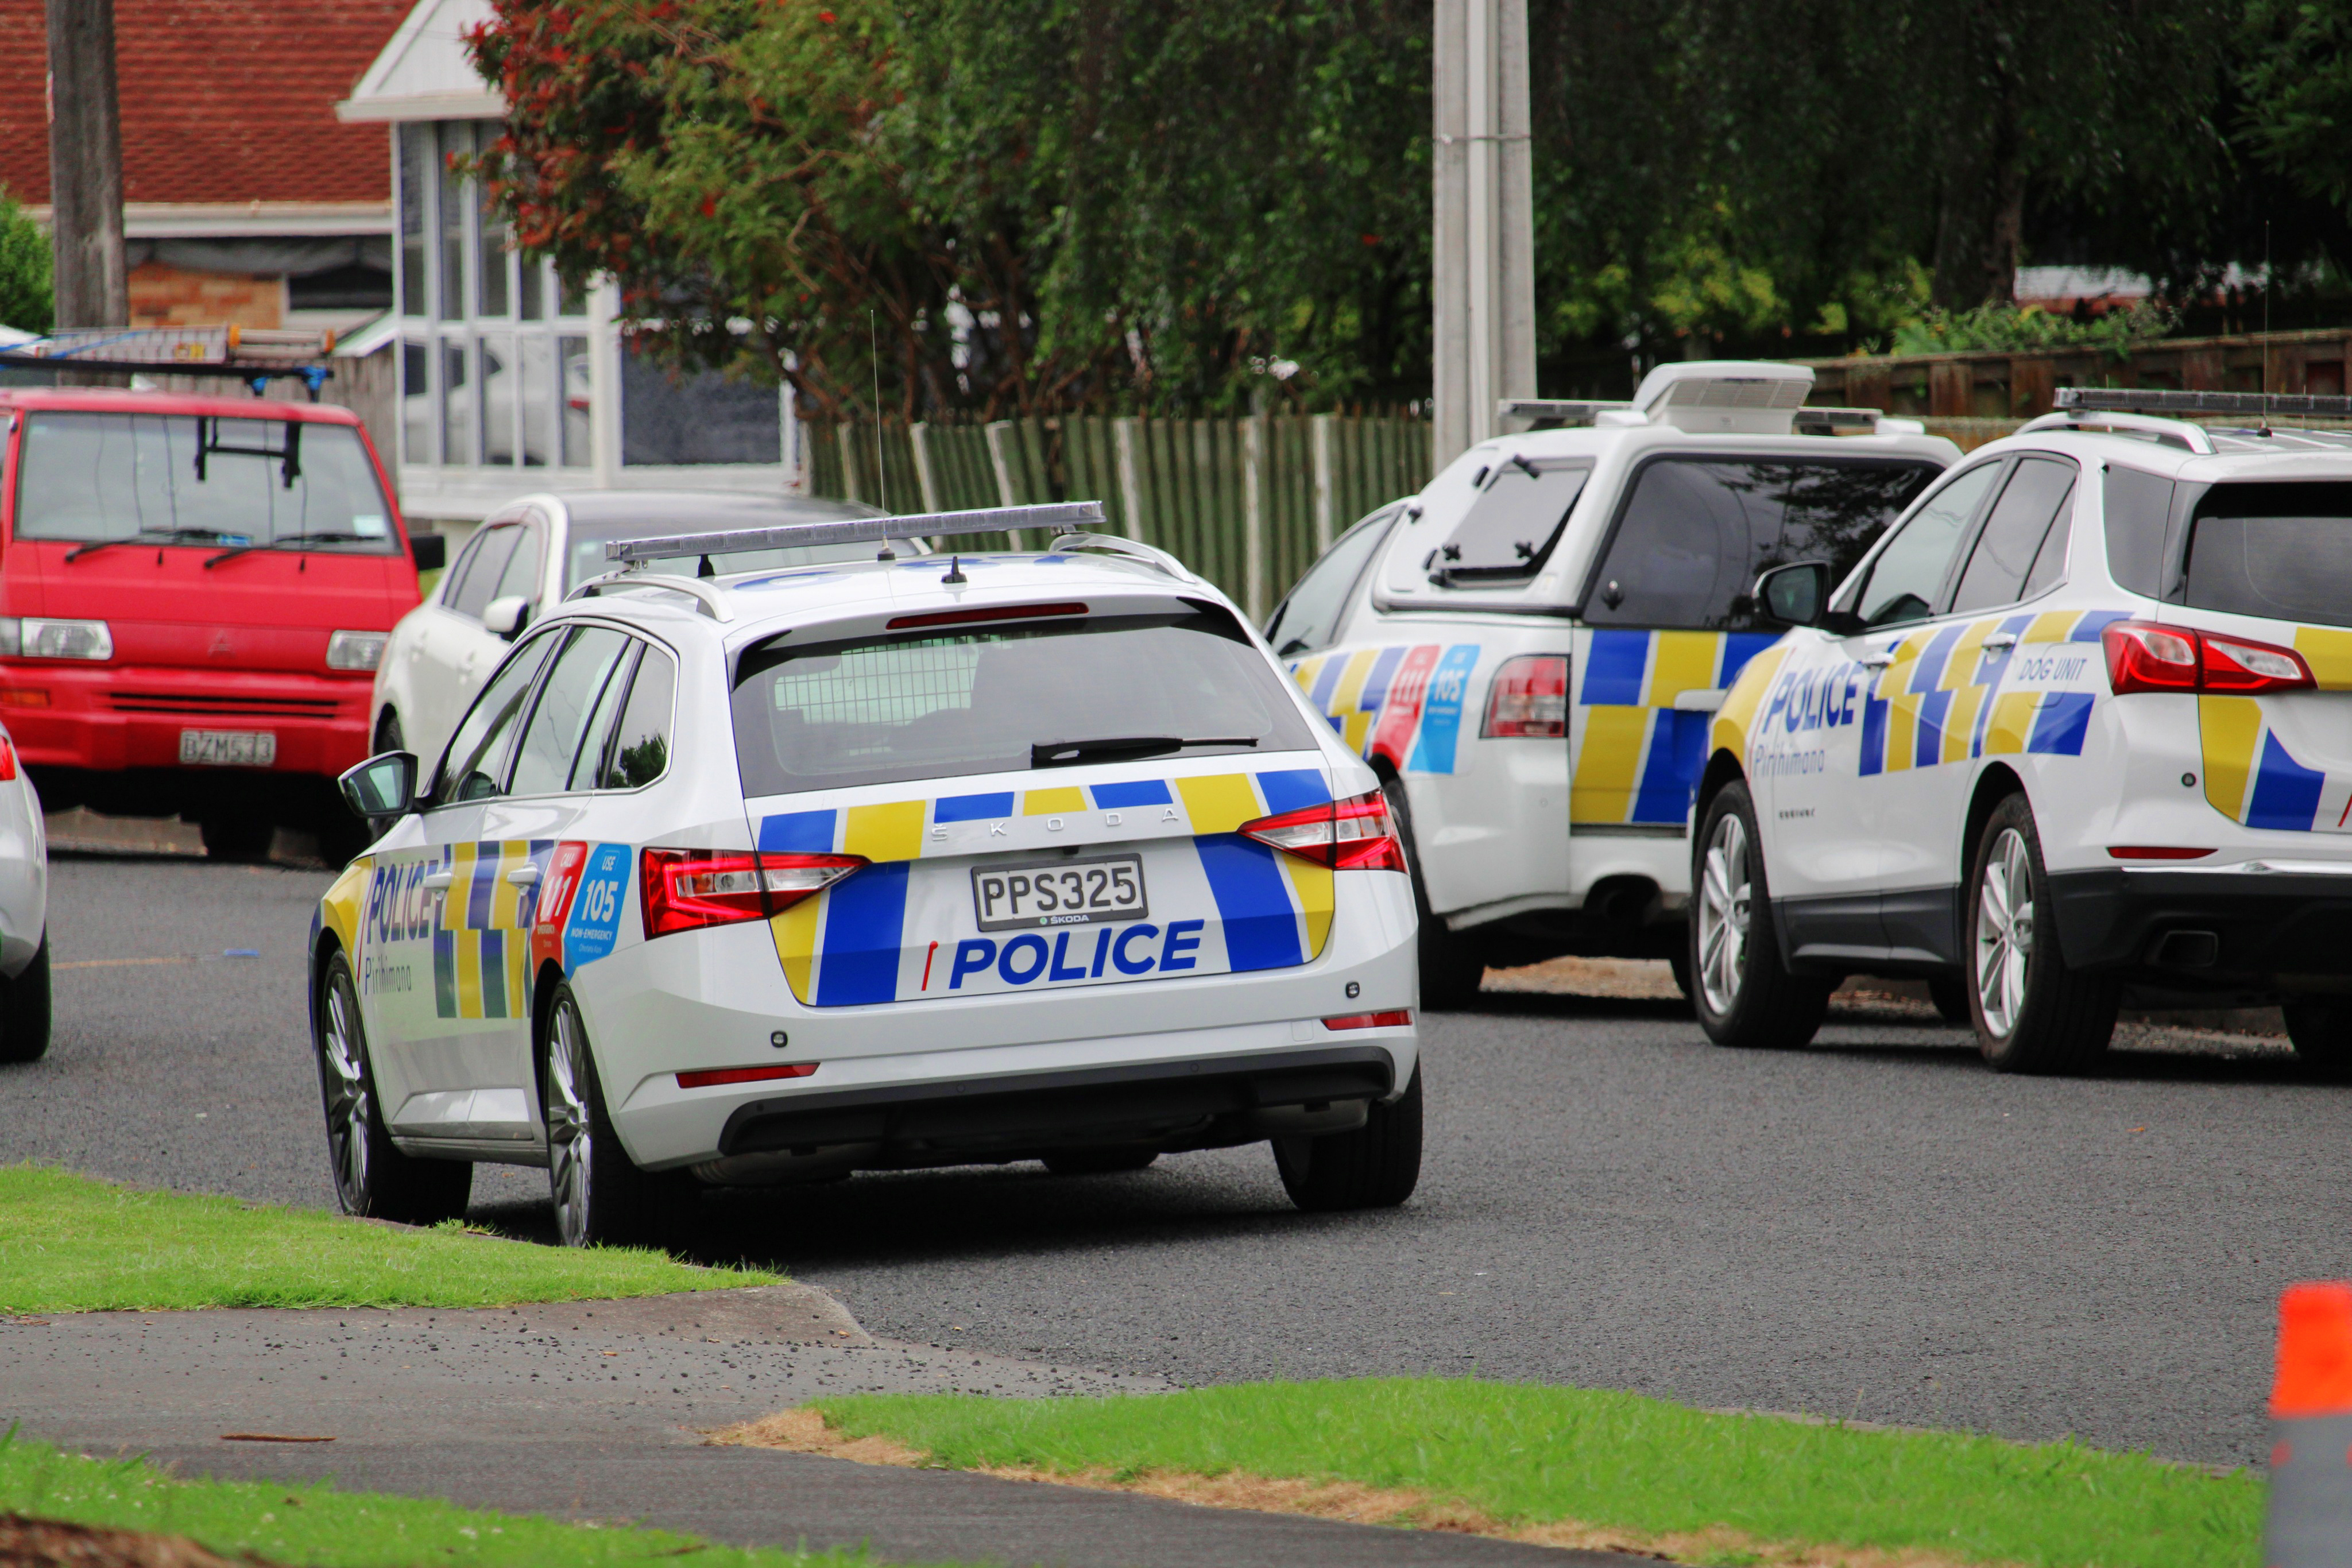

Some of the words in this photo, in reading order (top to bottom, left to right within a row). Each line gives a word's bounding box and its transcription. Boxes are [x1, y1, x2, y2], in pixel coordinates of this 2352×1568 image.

[2018, 657, 2053, 681] DOG
[2053, 657, 2087, 680] UNIT
[1395, 670, 1425, 702] 111
[1434, 671, 1467, 702] 105
[1762, 661, 1864, 734] POLICE
[931, 808, 1179, 842] ŠKODA
[560, 853, 575, 868] CALL
[602, 855, 616, 872] USE
[367, 860, 439, 944] POLICE
[540, 876, 572, 917] 111
[581, 879, 618, 923] 105
[982, 866, 1136, 916] PPS325
[571, 927, 613, 940] NON-EMERGENCY
[1050, 914, 1089, 925] ŠKODA
[949, 919, 1205, 990] POLICE
